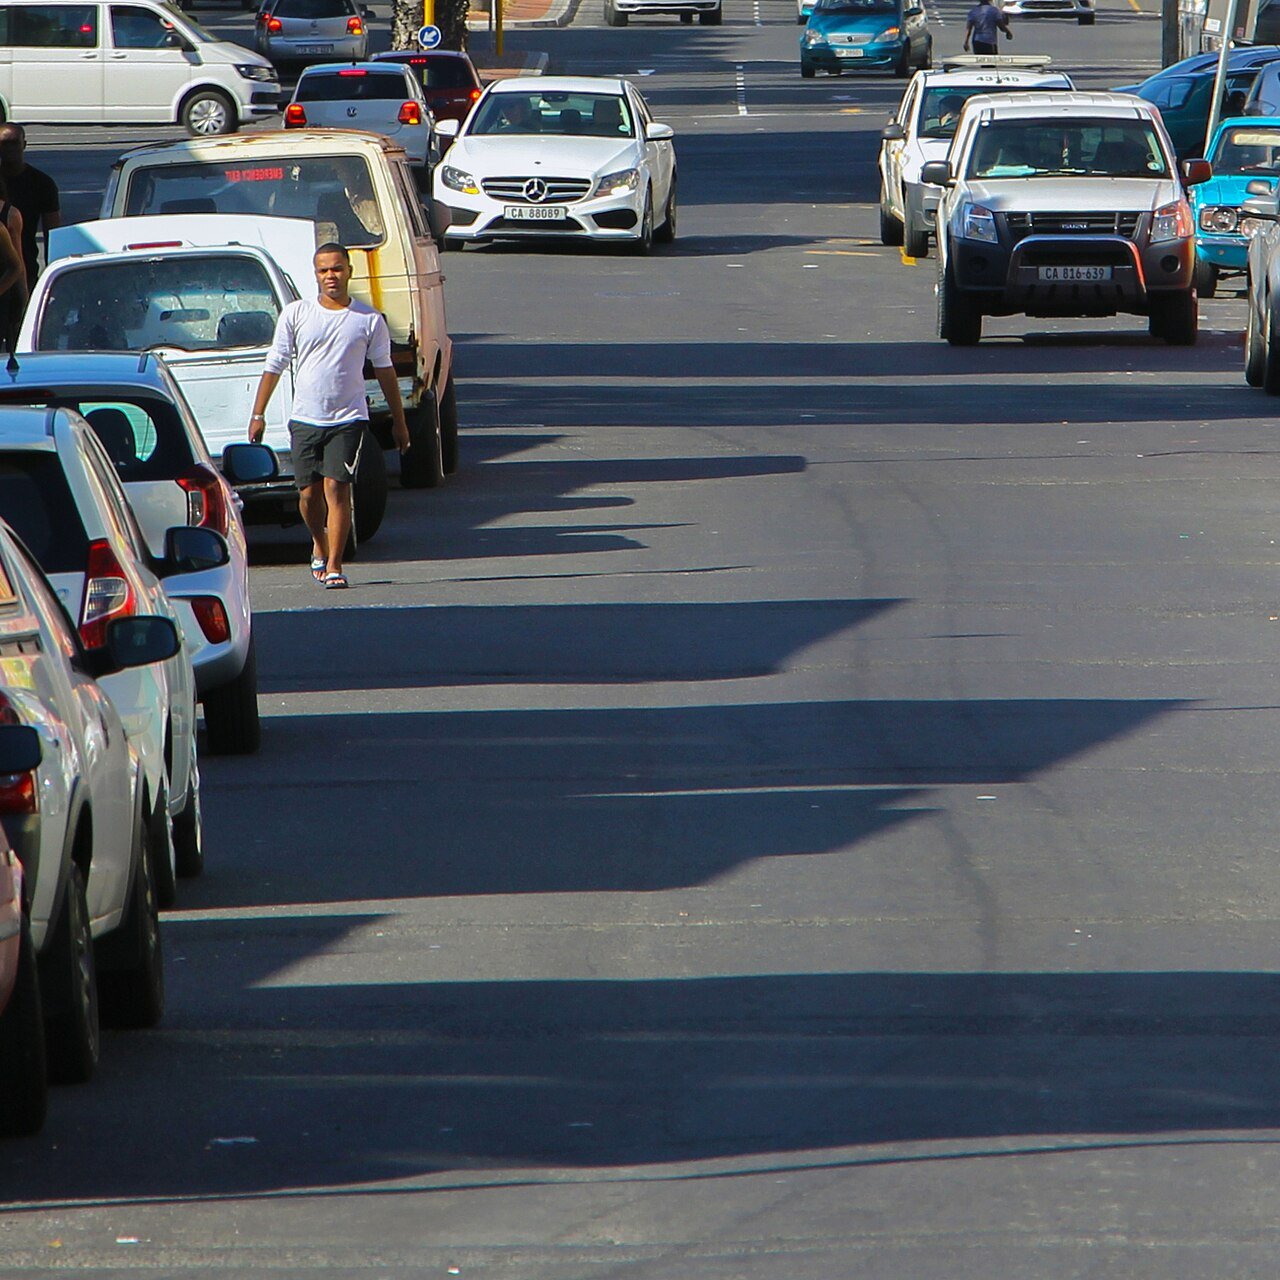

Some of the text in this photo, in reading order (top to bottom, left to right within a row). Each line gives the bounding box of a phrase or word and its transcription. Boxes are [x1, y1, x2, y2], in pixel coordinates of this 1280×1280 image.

[511, 208, 560, 218] CA 88089
[1045, 267, 1105, 280] CA 816-639
